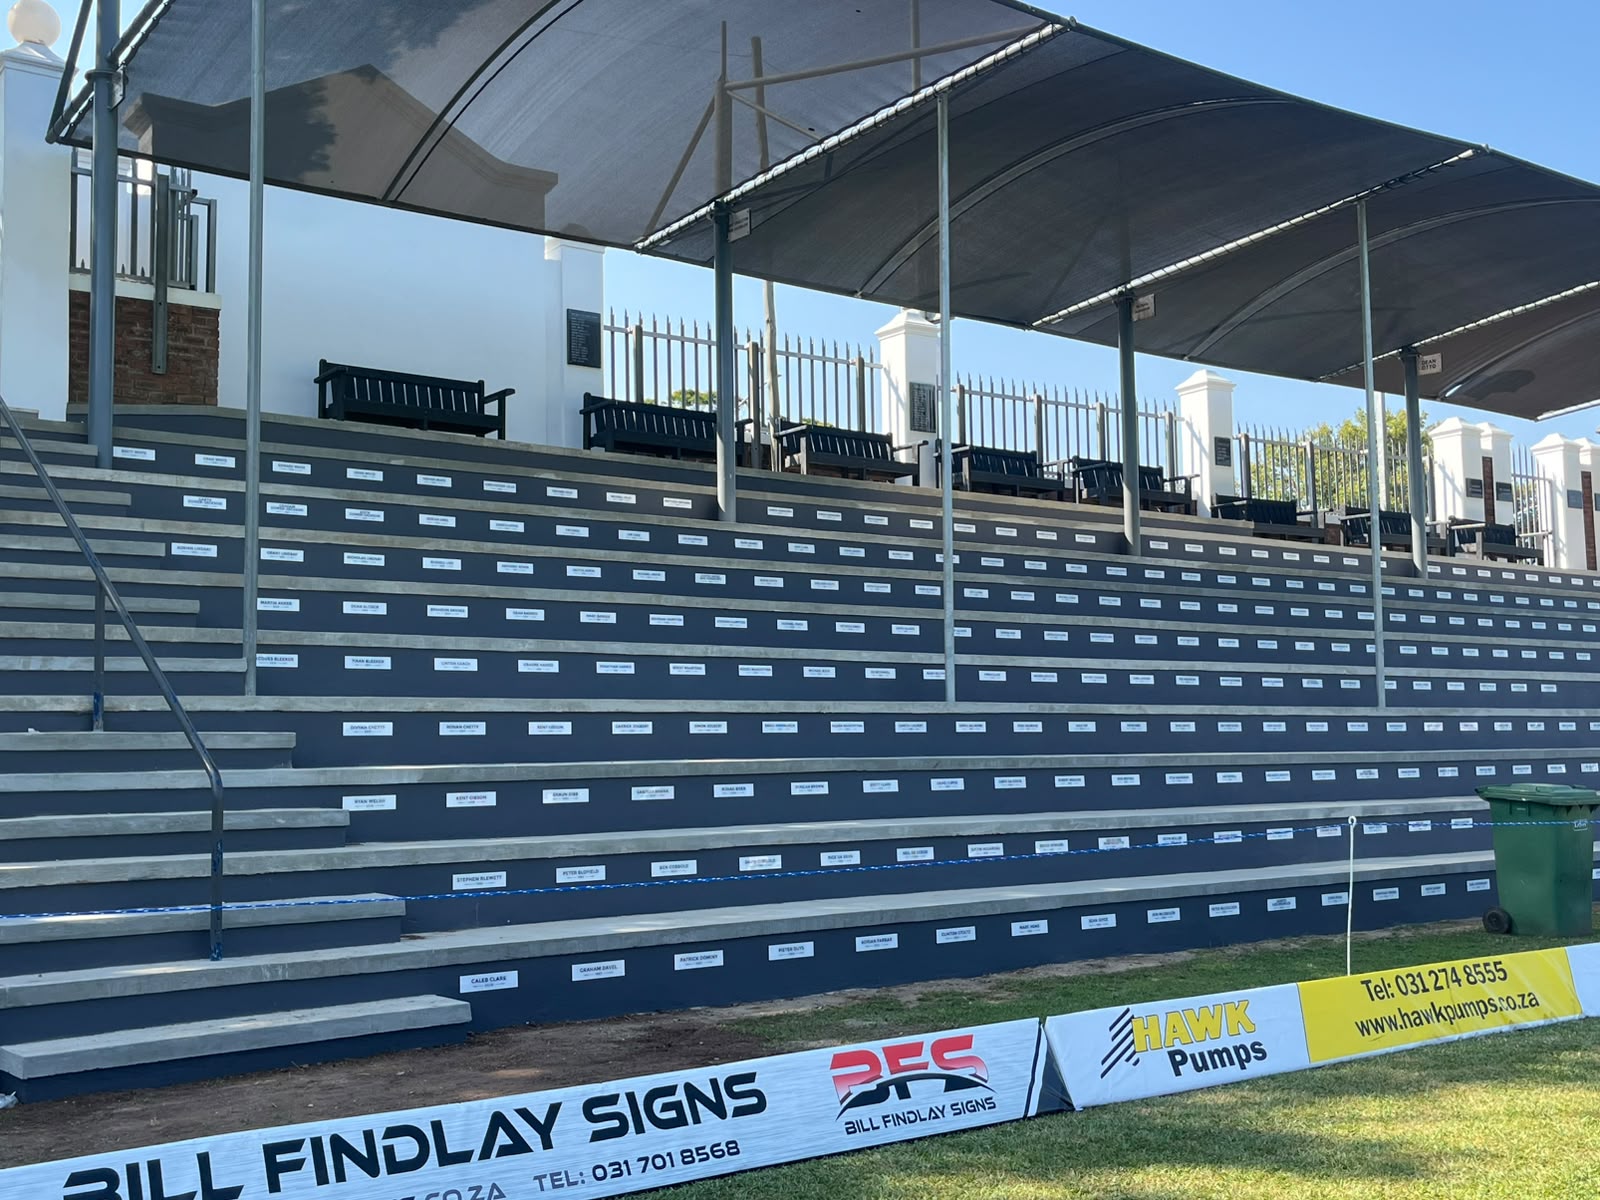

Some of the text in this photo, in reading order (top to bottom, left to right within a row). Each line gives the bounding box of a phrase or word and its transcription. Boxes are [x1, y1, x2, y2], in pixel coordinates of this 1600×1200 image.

[1360, 961, 1508, 1001] Tel: 031 274 8555
[1131, 1000, 1256, 1053] HAWK
[1355, 991, 1540, 1037] www.hawkpumps.co.za
[1167, 1041, 1267, 1077] Pumps
[63, 1071, 768, 1200] BILL FINDLAY SIGNS
[844, 1096, 997, 1135] BILL FINDLAY SIGNS
[533, 1169, 587, 1192] TEL:
[592, 1159, 632, 1182] 031
[636, 1151, 676, 1174] 701
[680, 1139, 741, 1165] 8568
